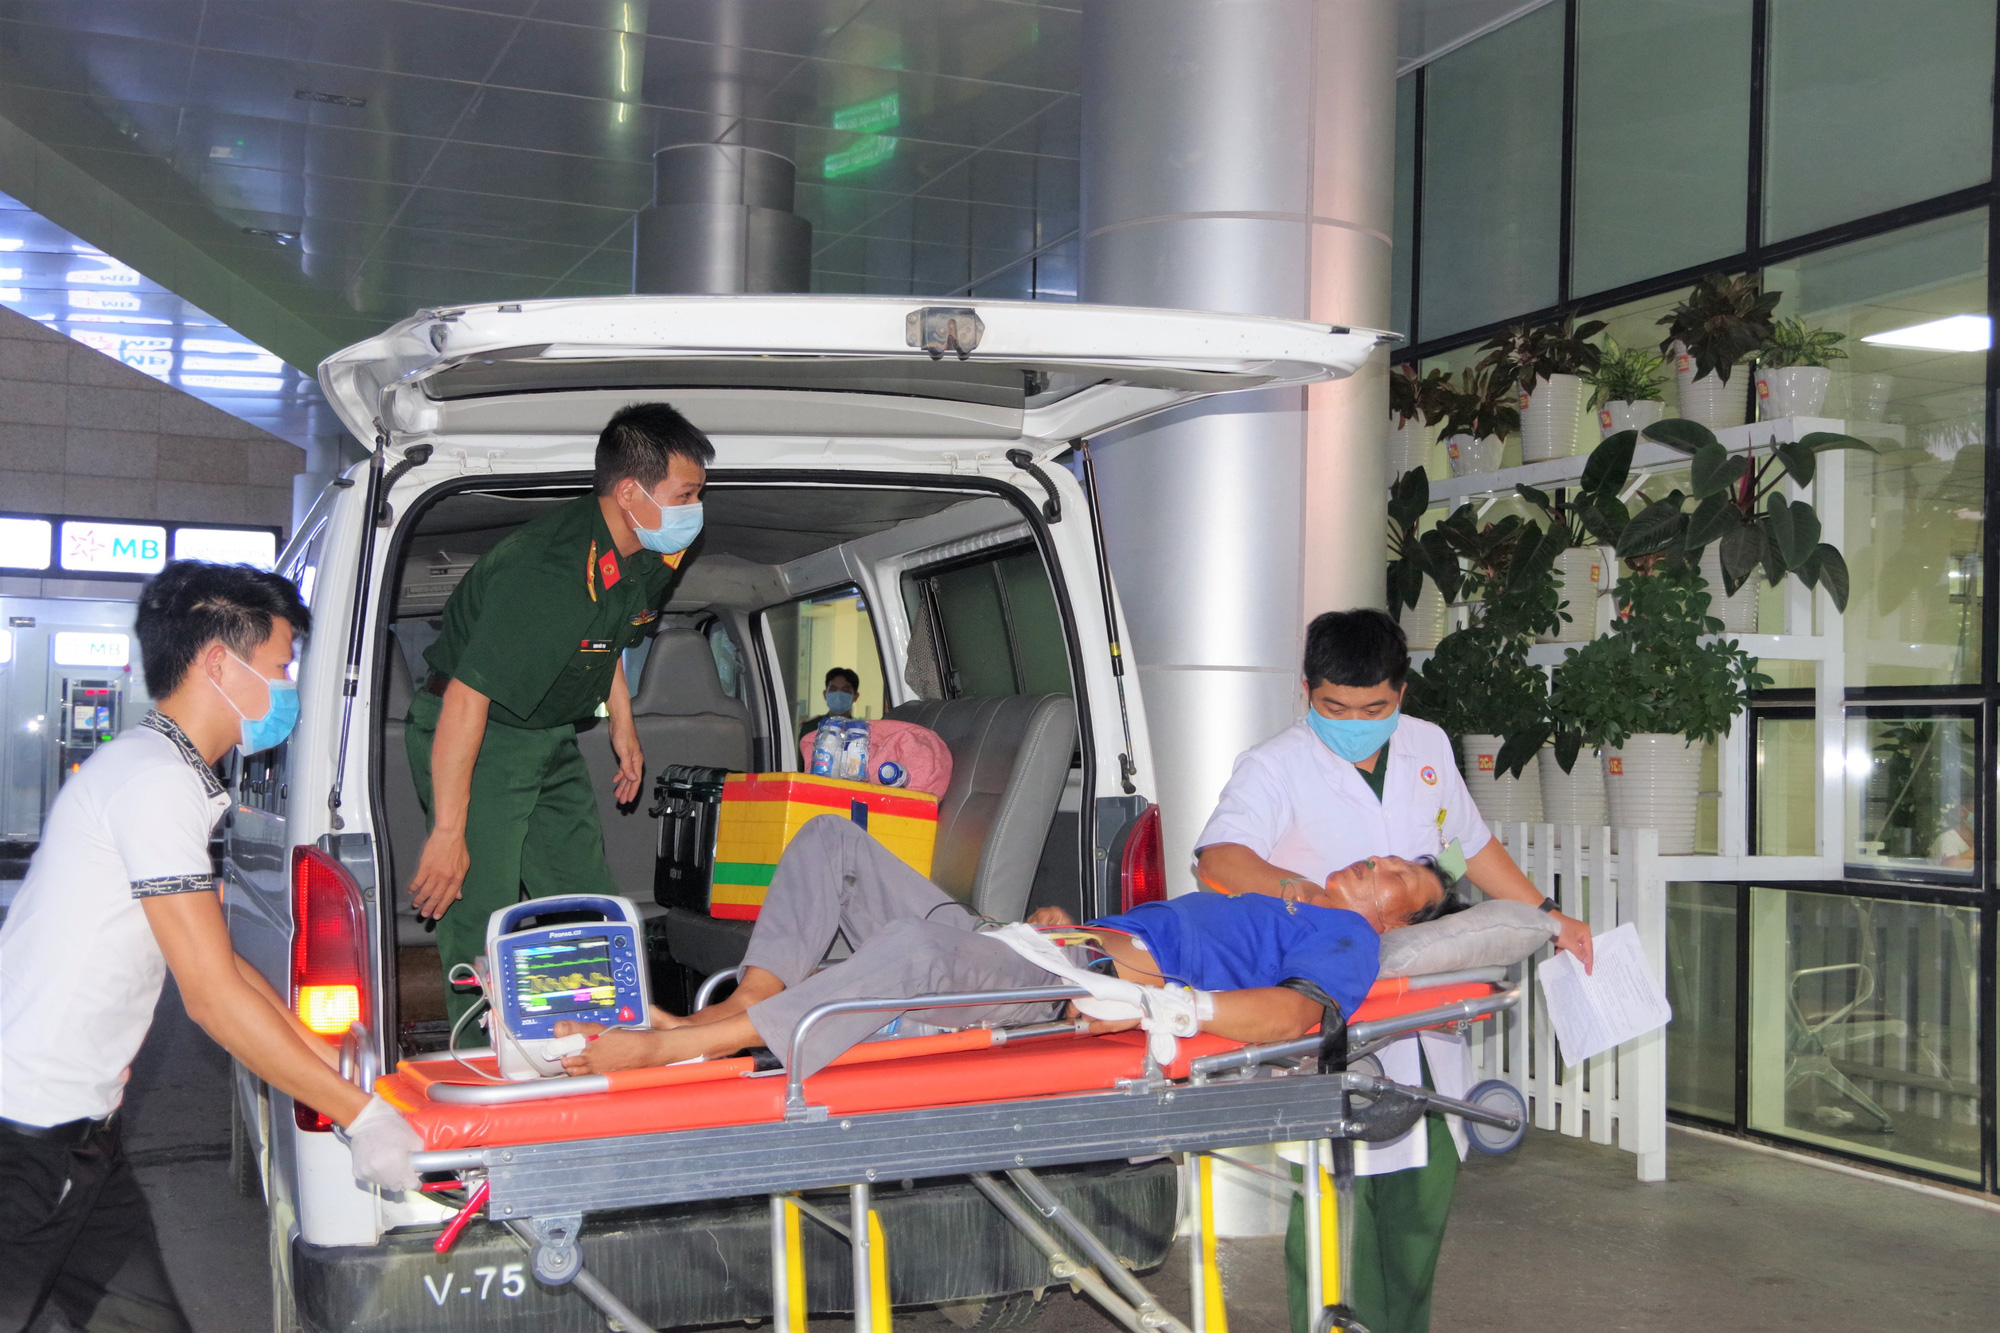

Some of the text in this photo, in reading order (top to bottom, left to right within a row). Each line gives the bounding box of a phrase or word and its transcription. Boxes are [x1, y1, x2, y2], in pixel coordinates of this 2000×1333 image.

[111, 537, 160, 560] MB
[89, 642, 121, 656] MB
[424, 1263, 526, 1306] V-75
